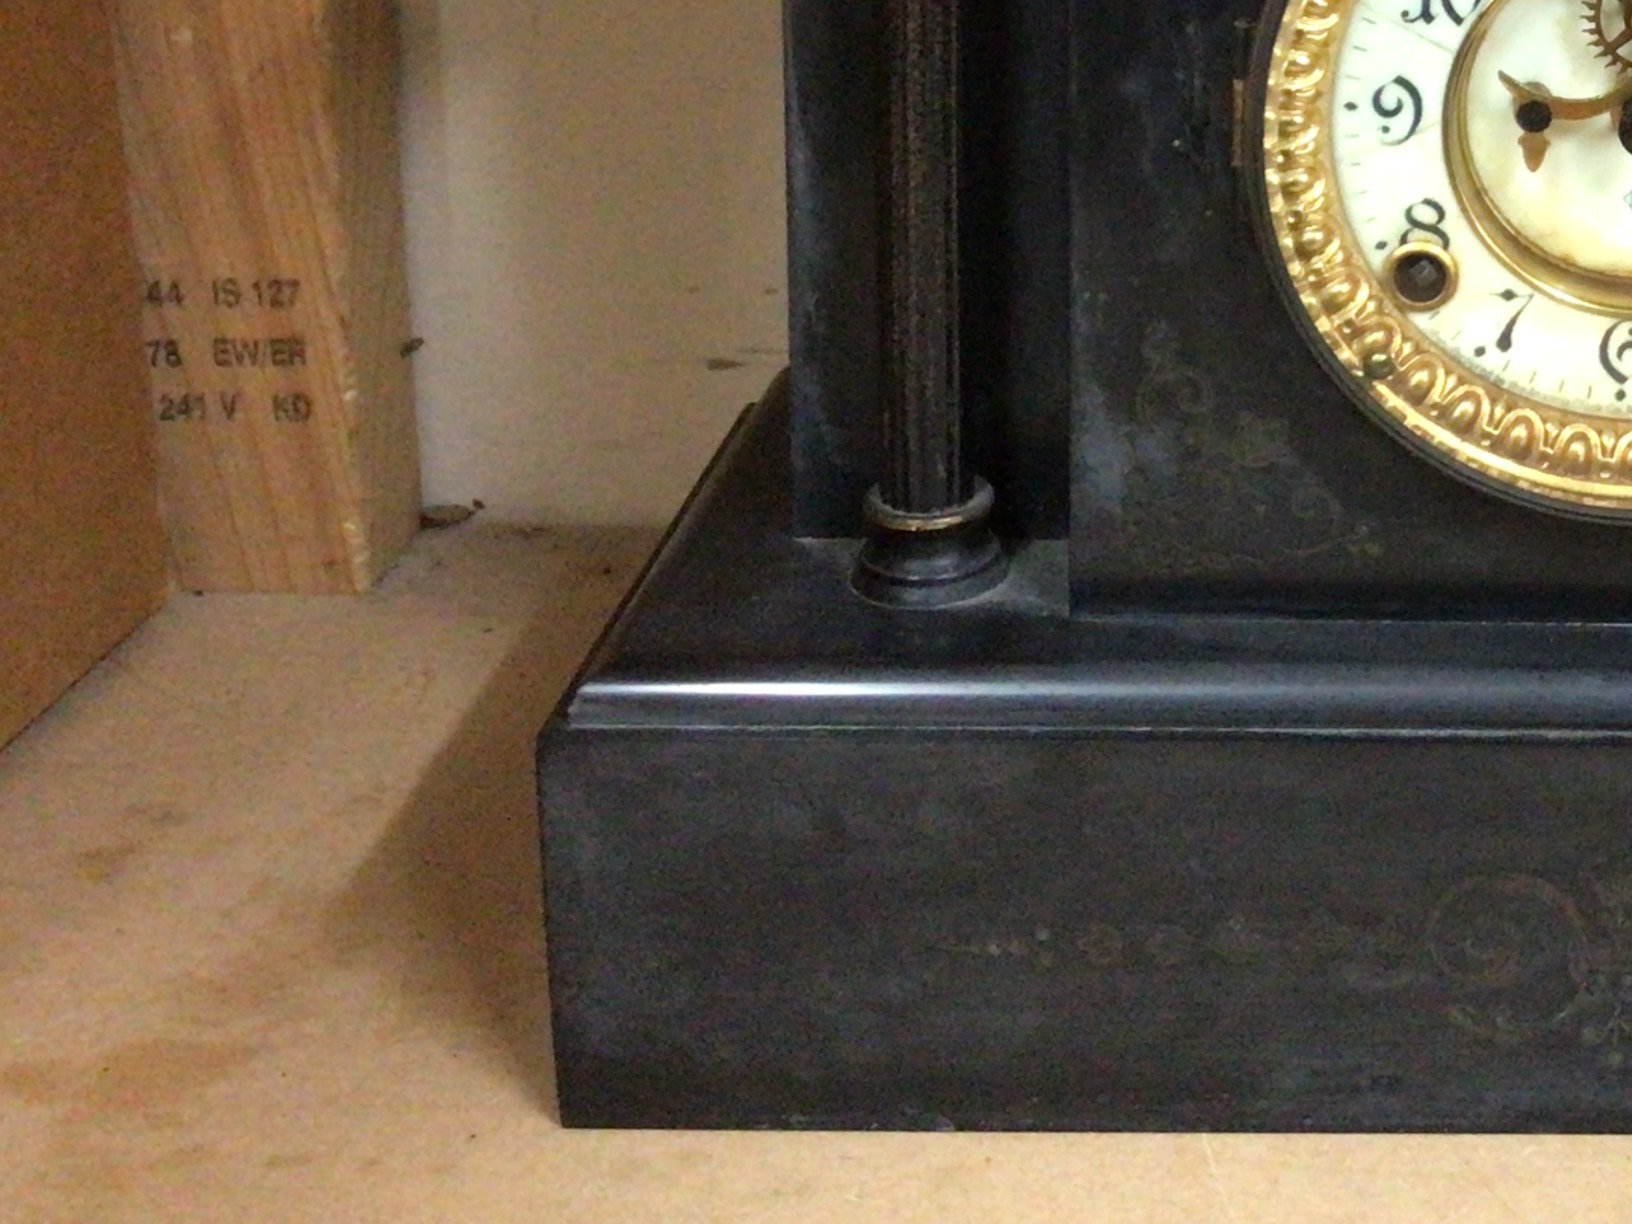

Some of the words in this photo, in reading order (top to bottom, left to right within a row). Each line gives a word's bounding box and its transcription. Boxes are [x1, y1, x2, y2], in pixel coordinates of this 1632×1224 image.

[1372, 74, 1424, 145] 9
[1400, 198, 1448, 248] 8
[1488, 287, 1534, 353] 7
